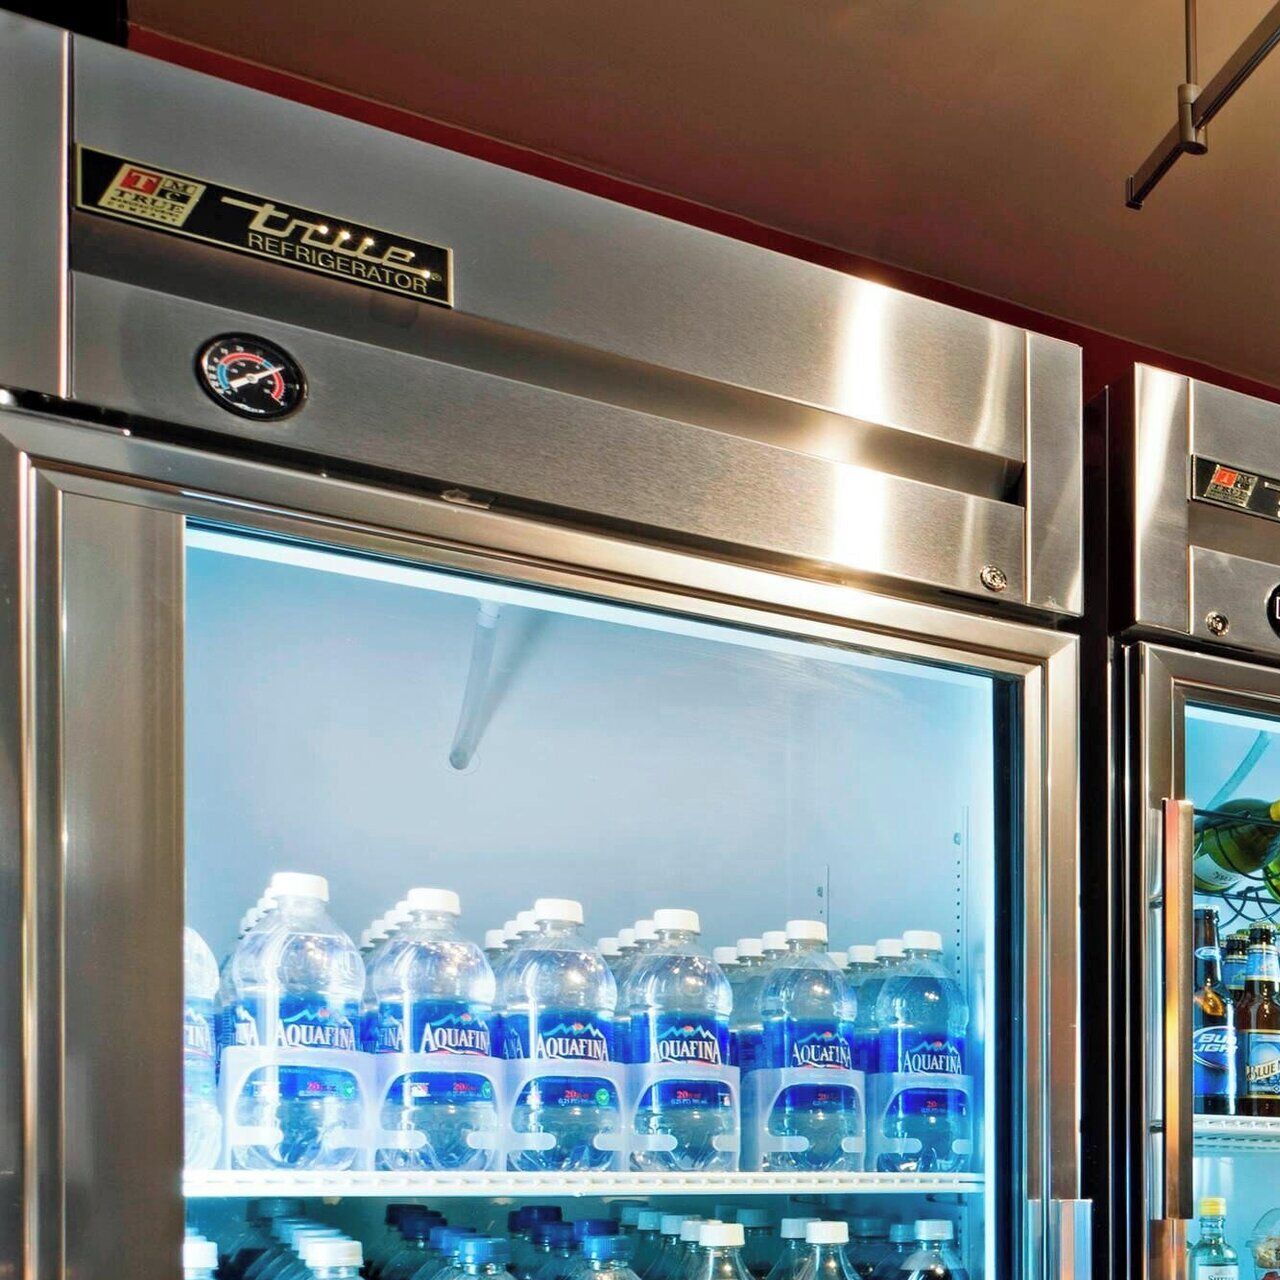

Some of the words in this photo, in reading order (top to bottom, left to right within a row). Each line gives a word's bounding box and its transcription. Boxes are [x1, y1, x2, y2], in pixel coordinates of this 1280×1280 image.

[248, 232, 429, 293] REFRIGERATOR
[536, 1033, 610, 1062] AQUAFINA
[903, 1050, 961, 1074] AQUAFINA
